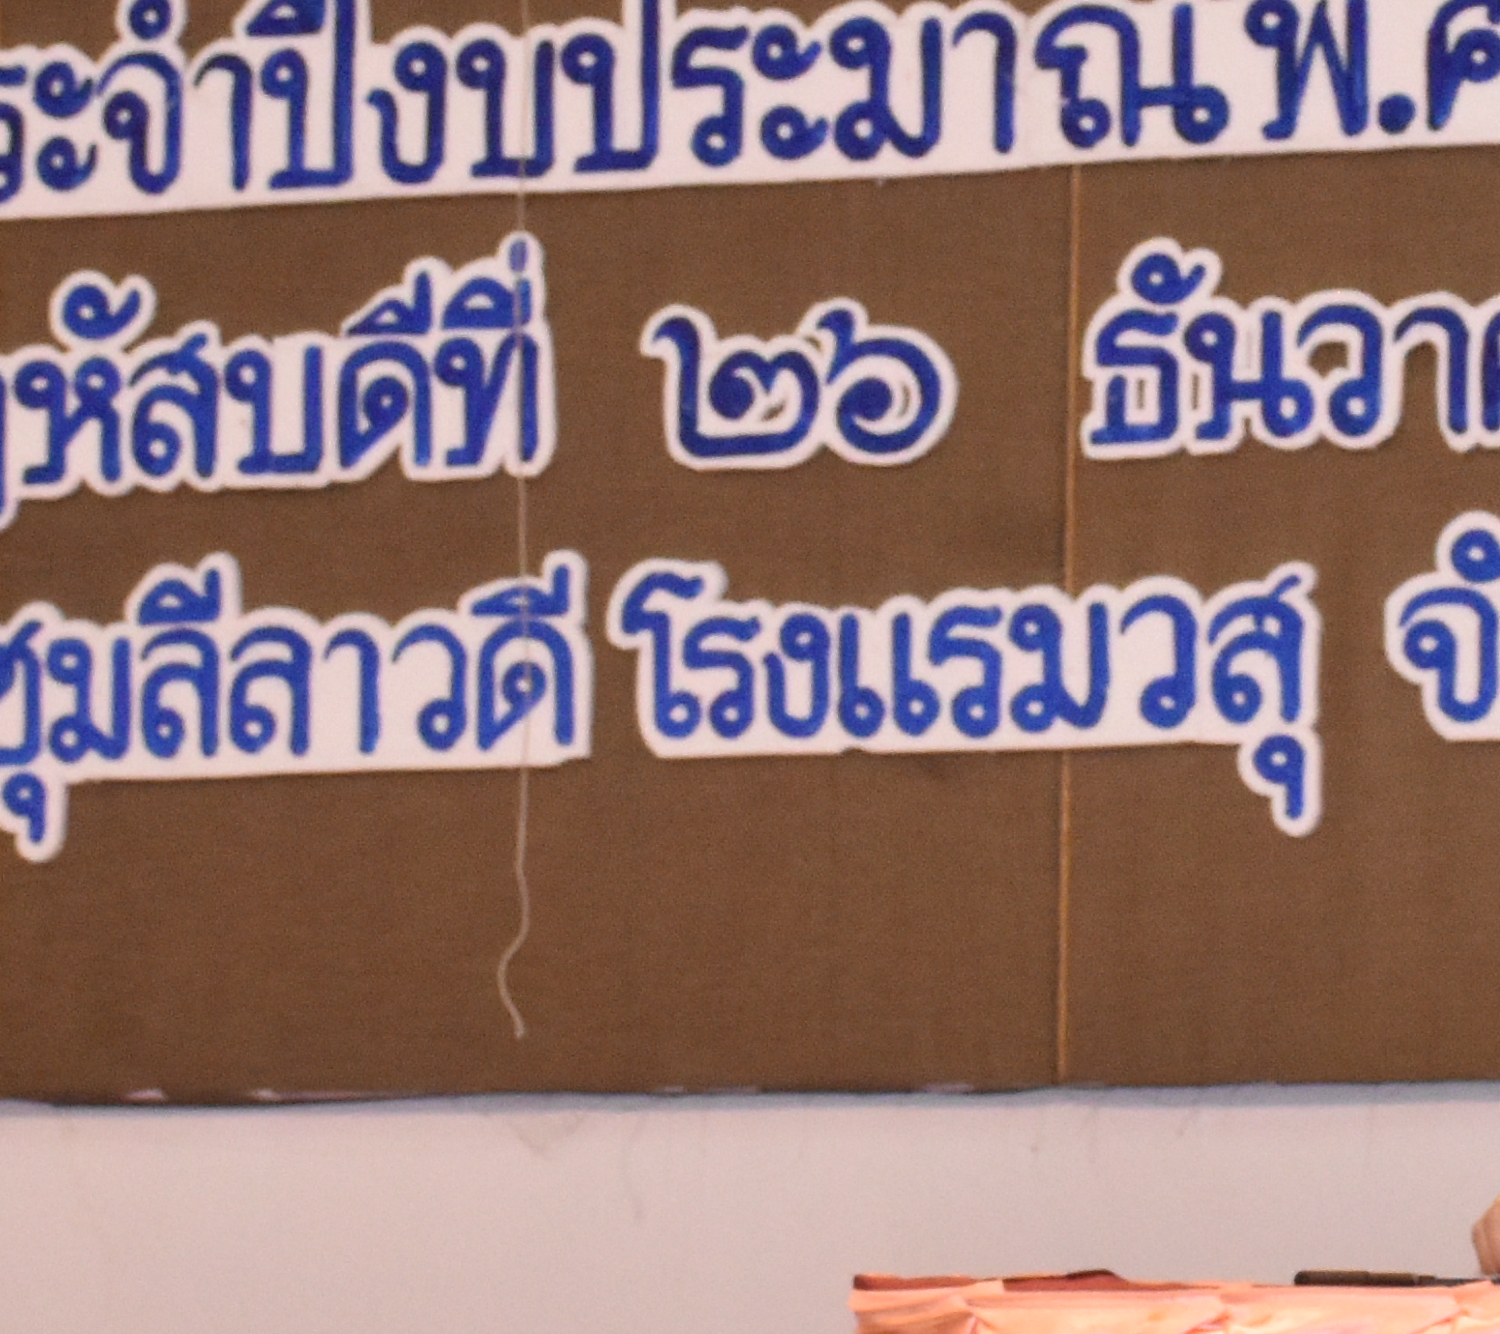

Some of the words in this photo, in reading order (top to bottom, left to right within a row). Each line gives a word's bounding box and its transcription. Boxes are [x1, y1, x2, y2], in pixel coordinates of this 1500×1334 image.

[655, 309, 943, 459] ๒๖
[620, 571, 1307, 820] โรงแรมวสุ
